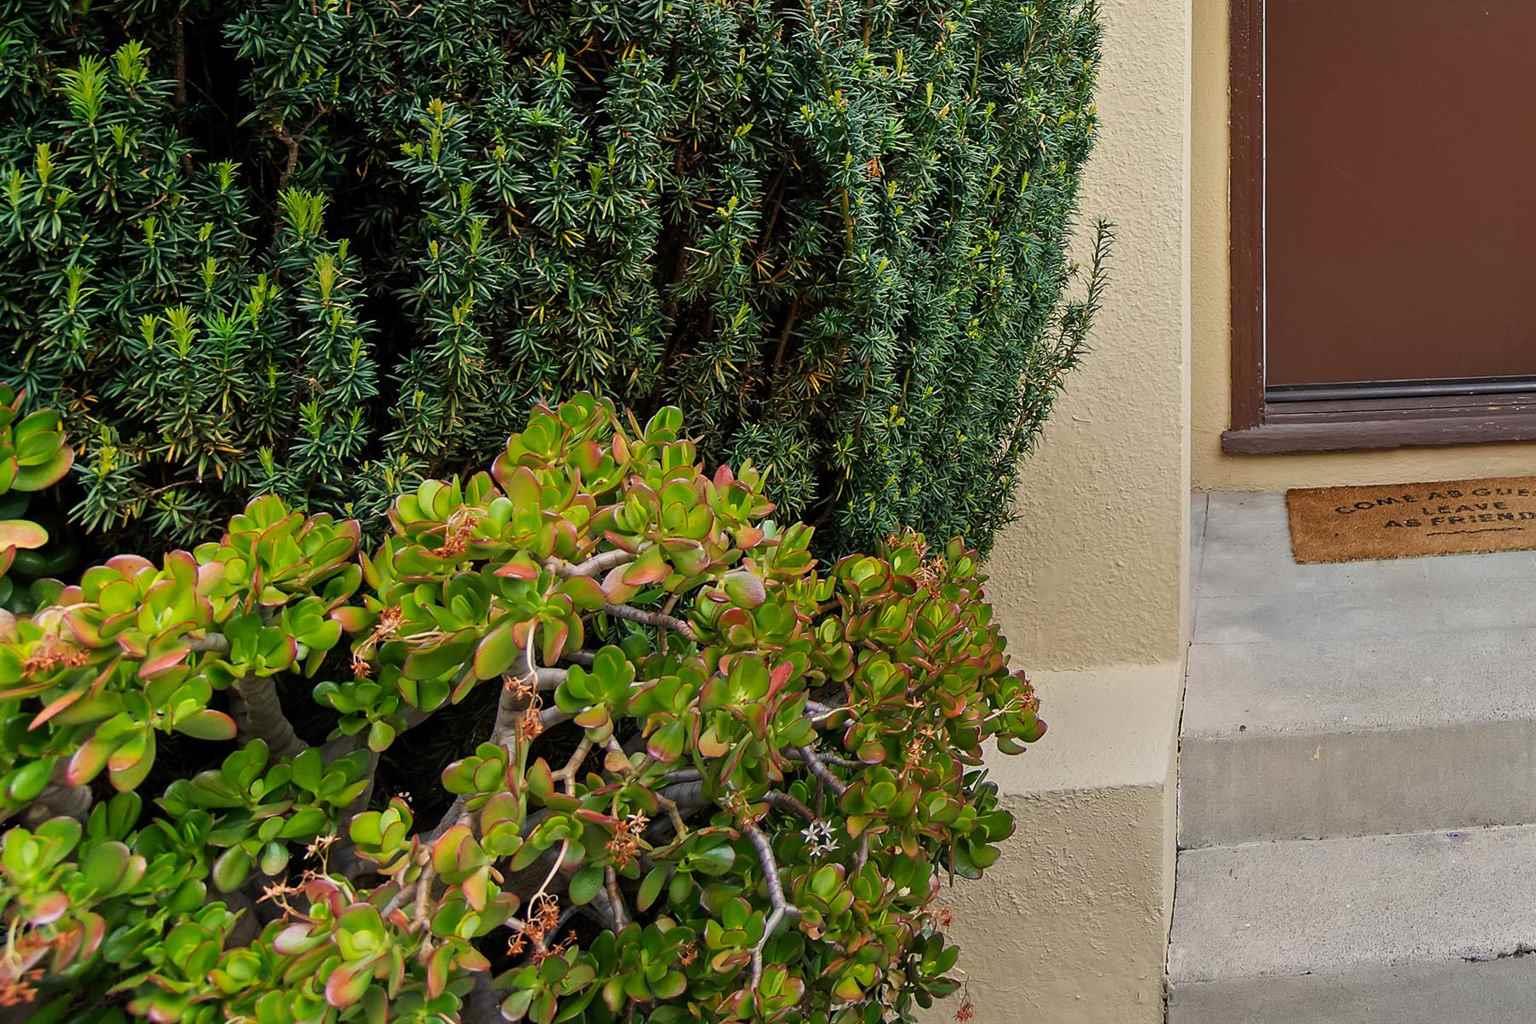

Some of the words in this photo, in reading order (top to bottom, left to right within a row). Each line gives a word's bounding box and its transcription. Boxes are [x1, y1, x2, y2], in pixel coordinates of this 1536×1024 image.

[1334, 494, 1419, 514] COME
[1428, 489, 1463, 501] AS
[1422, 501, 1509, 515] LEAVE
[1383, 517, 1422, 529] AS
